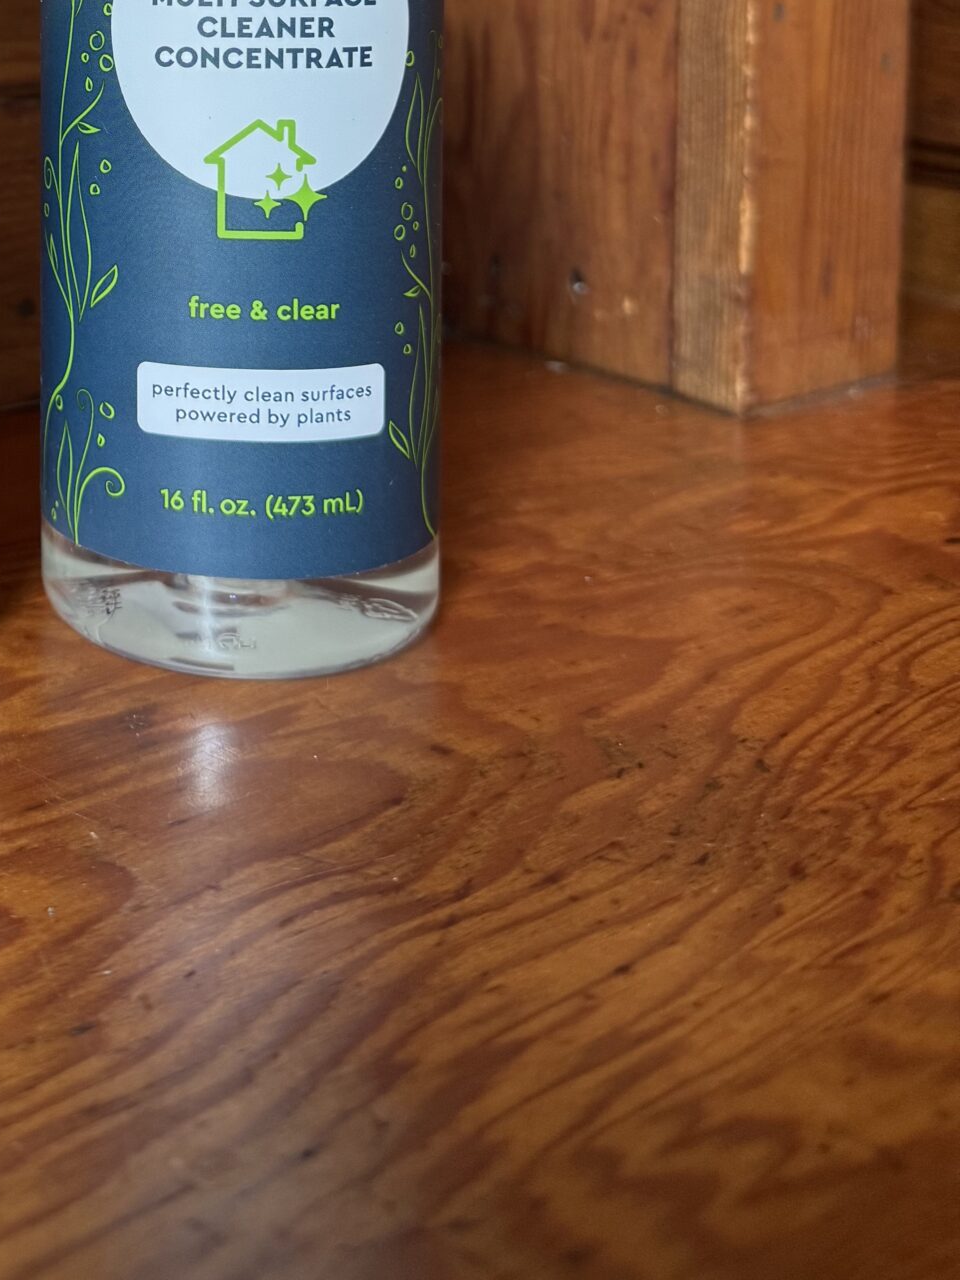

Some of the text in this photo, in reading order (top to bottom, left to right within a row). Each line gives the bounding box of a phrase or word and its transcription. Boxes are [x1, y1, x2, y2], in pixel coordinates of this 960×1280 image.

[197, 16, 335, 38] CLEANER
[155, 46, 372, 69] CONCENTRATE
[189, 296, 340, 321] free & clear
[151, 382, 373, 404] perfectly clean surfaces
[175, 405, 351, 427] powered by plants
[160, 489, 364, 518] 16 fl. oz. (473 mL)
